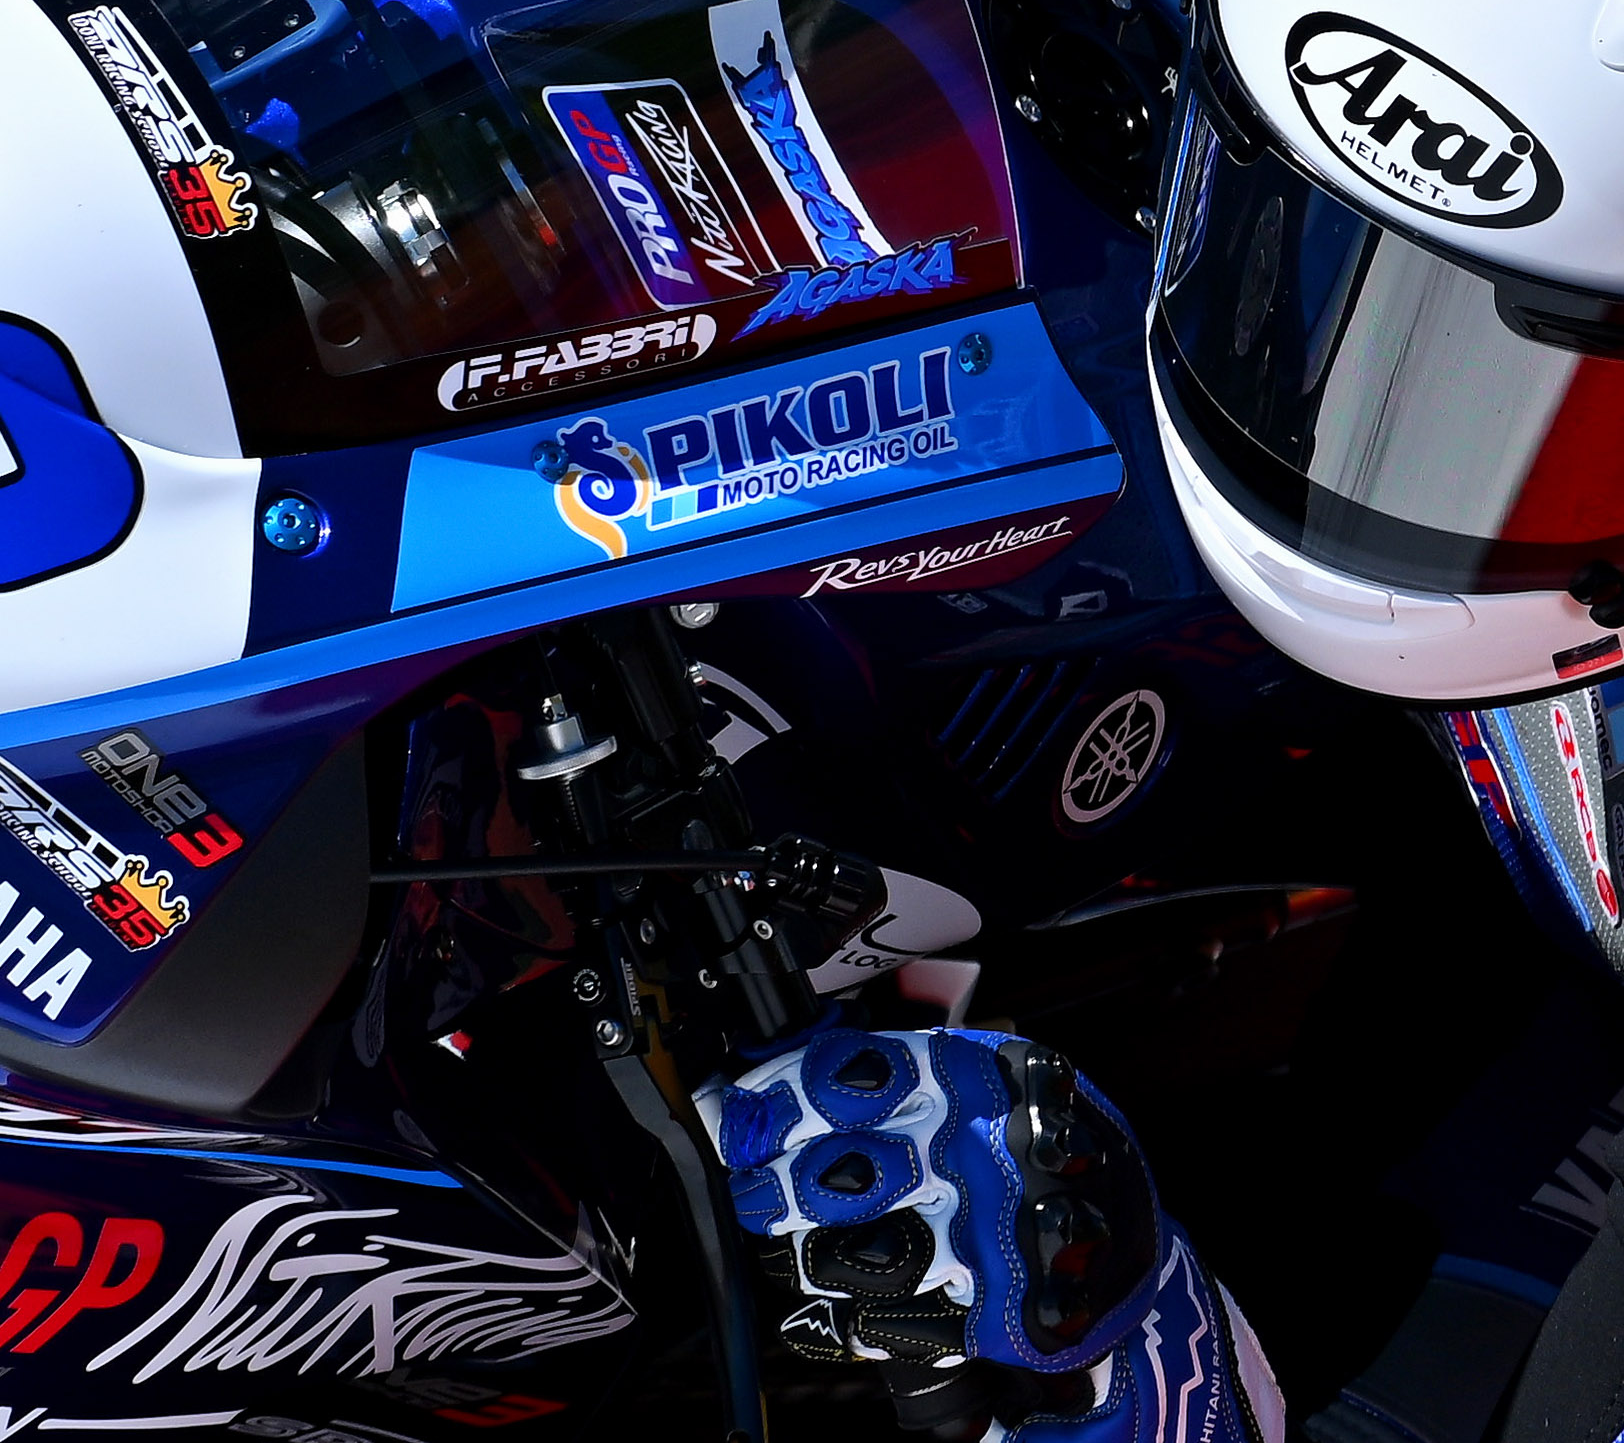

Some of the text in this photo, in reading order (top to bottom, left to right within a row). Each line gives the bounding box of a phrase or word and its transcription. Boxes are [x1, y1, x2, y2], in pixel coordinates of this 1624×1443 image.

[71, 17, 104, 55] DONI
[93, 52, 137, 108] RACING
[1292, 48, 1532, 201] Arai
[168, 166, 227, 236] 35
[1341, 130, 1445, 200] HELMET
[467, 349, 686, 402] ACCESSORI
[648, 347, 953, 490] PIKOLI
[723, 430, 956, 506] MOTO RACING OIL
[986, 515, 1071, 556] Heart
[82, 750, 173, 836] MOTOSHOP
[94, 884, 168, 948] 35
